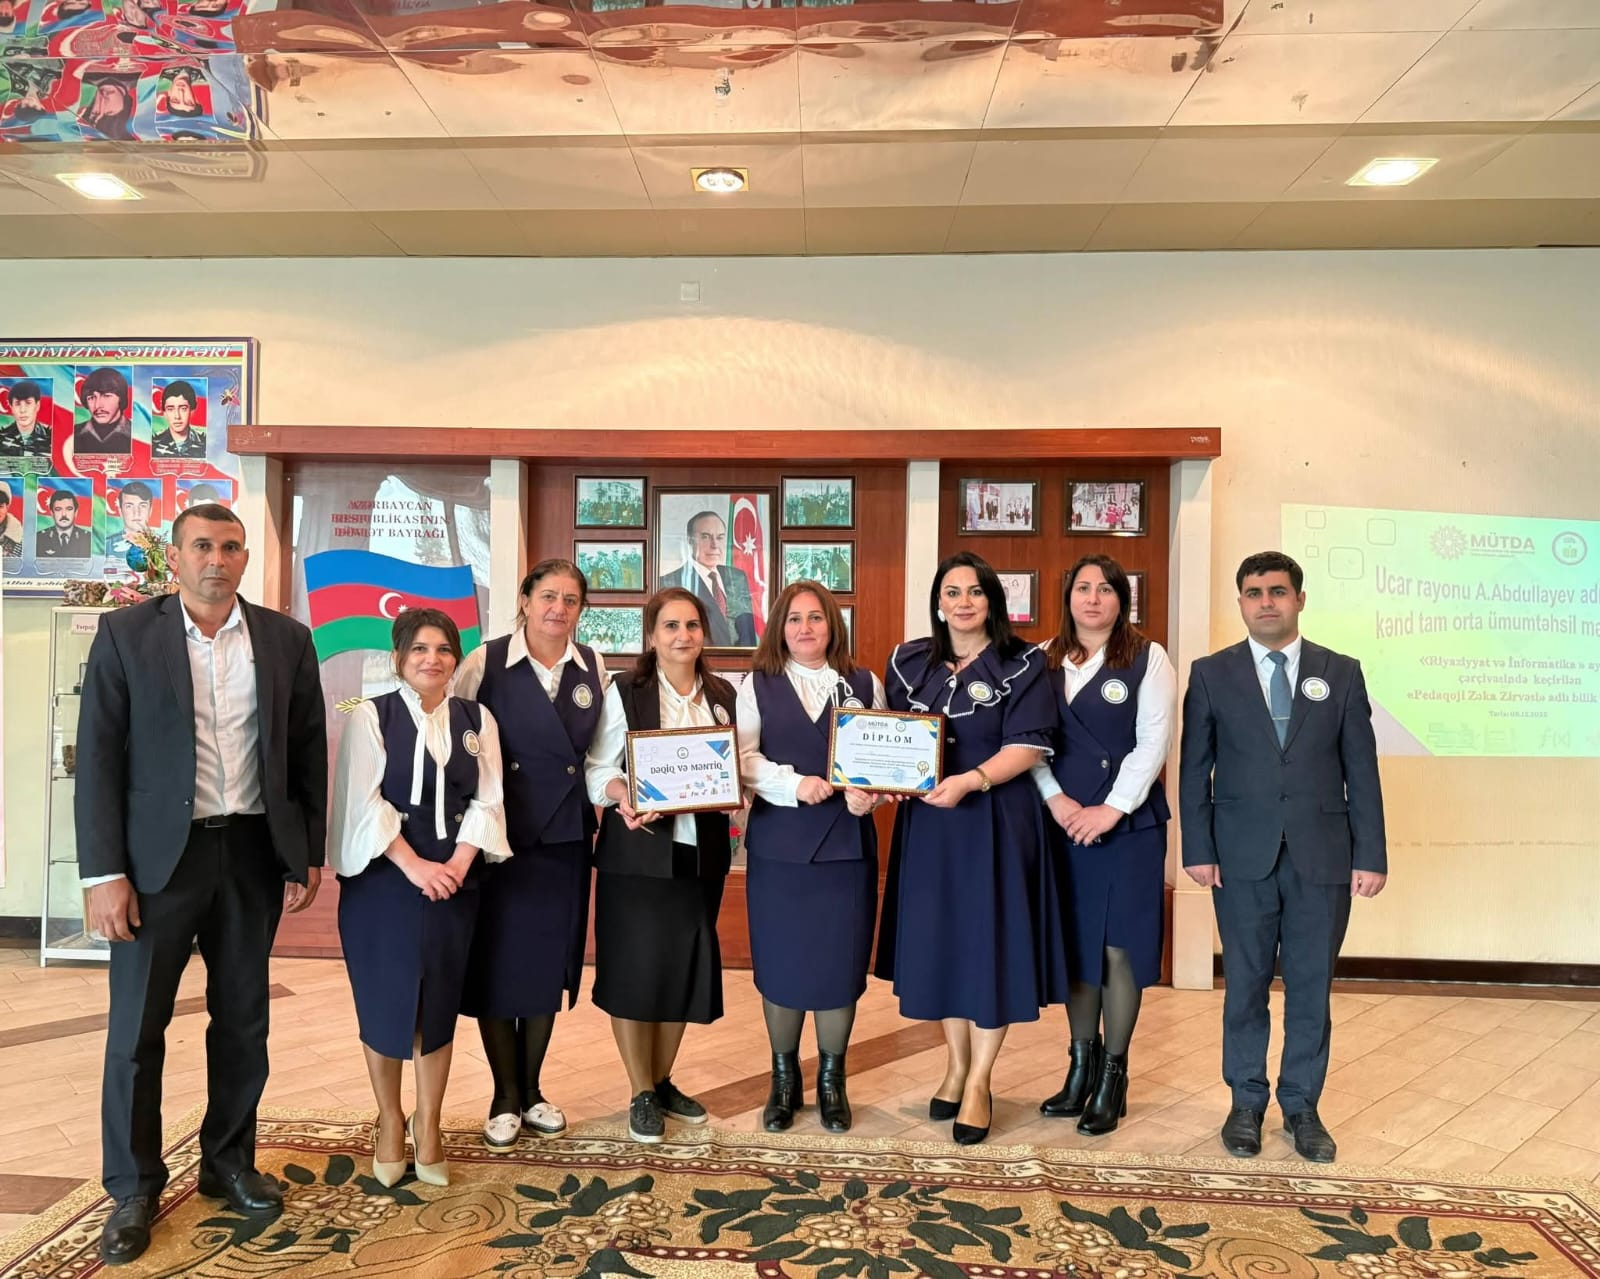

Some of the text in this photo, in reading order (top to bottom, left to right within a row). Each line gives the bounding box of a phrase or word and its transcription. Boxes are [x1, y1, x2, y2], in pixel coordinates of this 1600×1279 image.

[115, 344, 231, 360] ŞƏHİDLƏRİ
[348, 500, 432, 511] AZƏRBAYCAN
[331, 513, 449, 524] RESPUBLİKASININ
[334, 526, 445, 538] DÖVLƏT BAYRAĞI
[1471, 532, 1536, 550] MÜTDA
[1376, 565, 1412, 596] Ucar
[1417, 579, 1471, 604] rayonu
[1476, 582, 1575, 608] A.Abdullayev
[1376, 609, 1414, 640] kənd
[1419, 612, 1447, 634] tam
[1453, 612, 1482, 631] orta
[1488, 610, 1576, 635] ümumtəhsil
[1491, 658, 1505, 668] və
[1508, 655, 1577, 670] İnformatika
[1534, 673, 1582, 688] keçirilən
[1467, 689, 1496, 701] Zəka
[1572, 692, 1597, 703] bilik
[862, 731, 913, 744] DİPLOM
[650, 760, 724, 775] DƏQİQ VƏ MƏNTİQ
